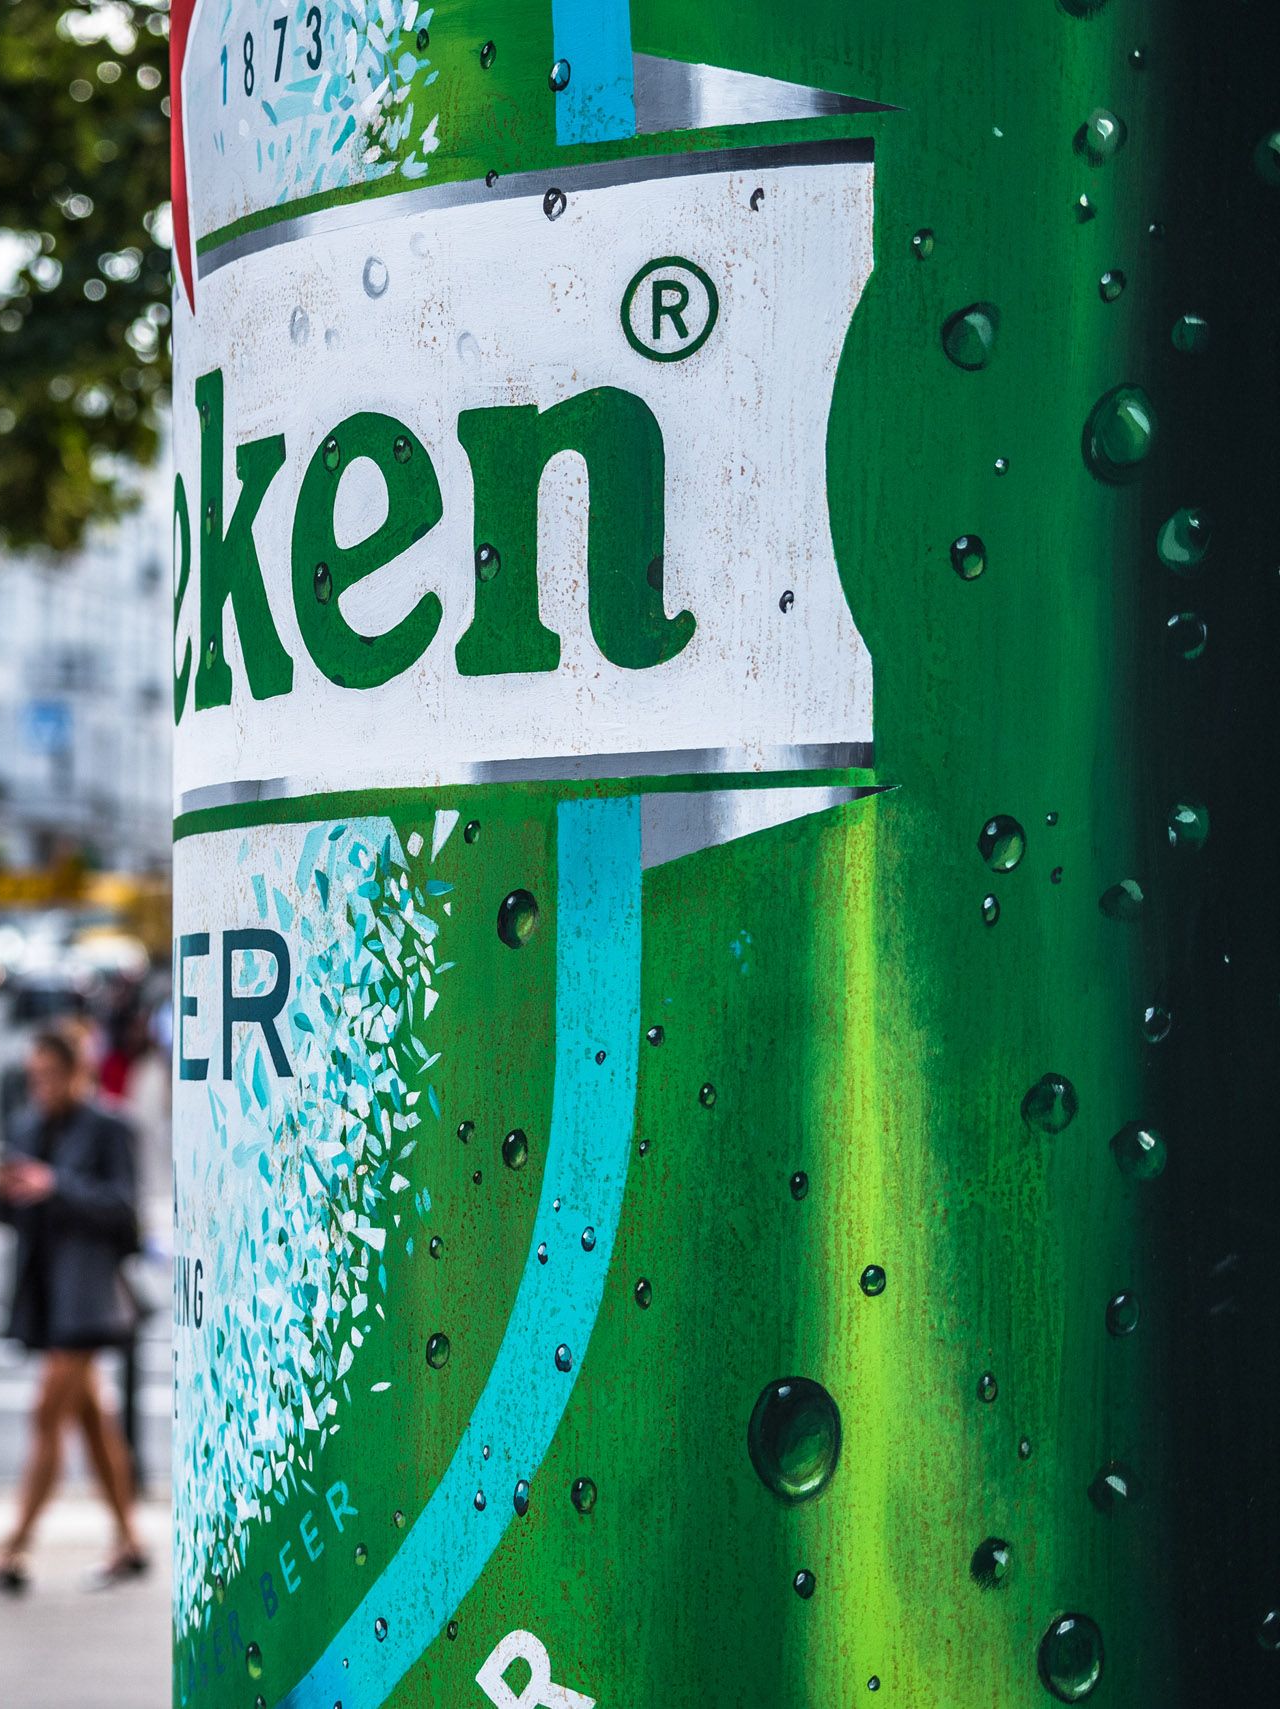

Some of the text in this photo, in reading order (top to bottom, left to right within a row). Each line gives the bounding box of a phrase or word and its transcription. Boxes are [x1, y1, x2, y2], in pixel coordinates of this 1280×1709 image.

[220, 6, 322, 106] 1873
[174, 928, 294, 1081] ER
[260, 1480, 359, 1620] BEER
